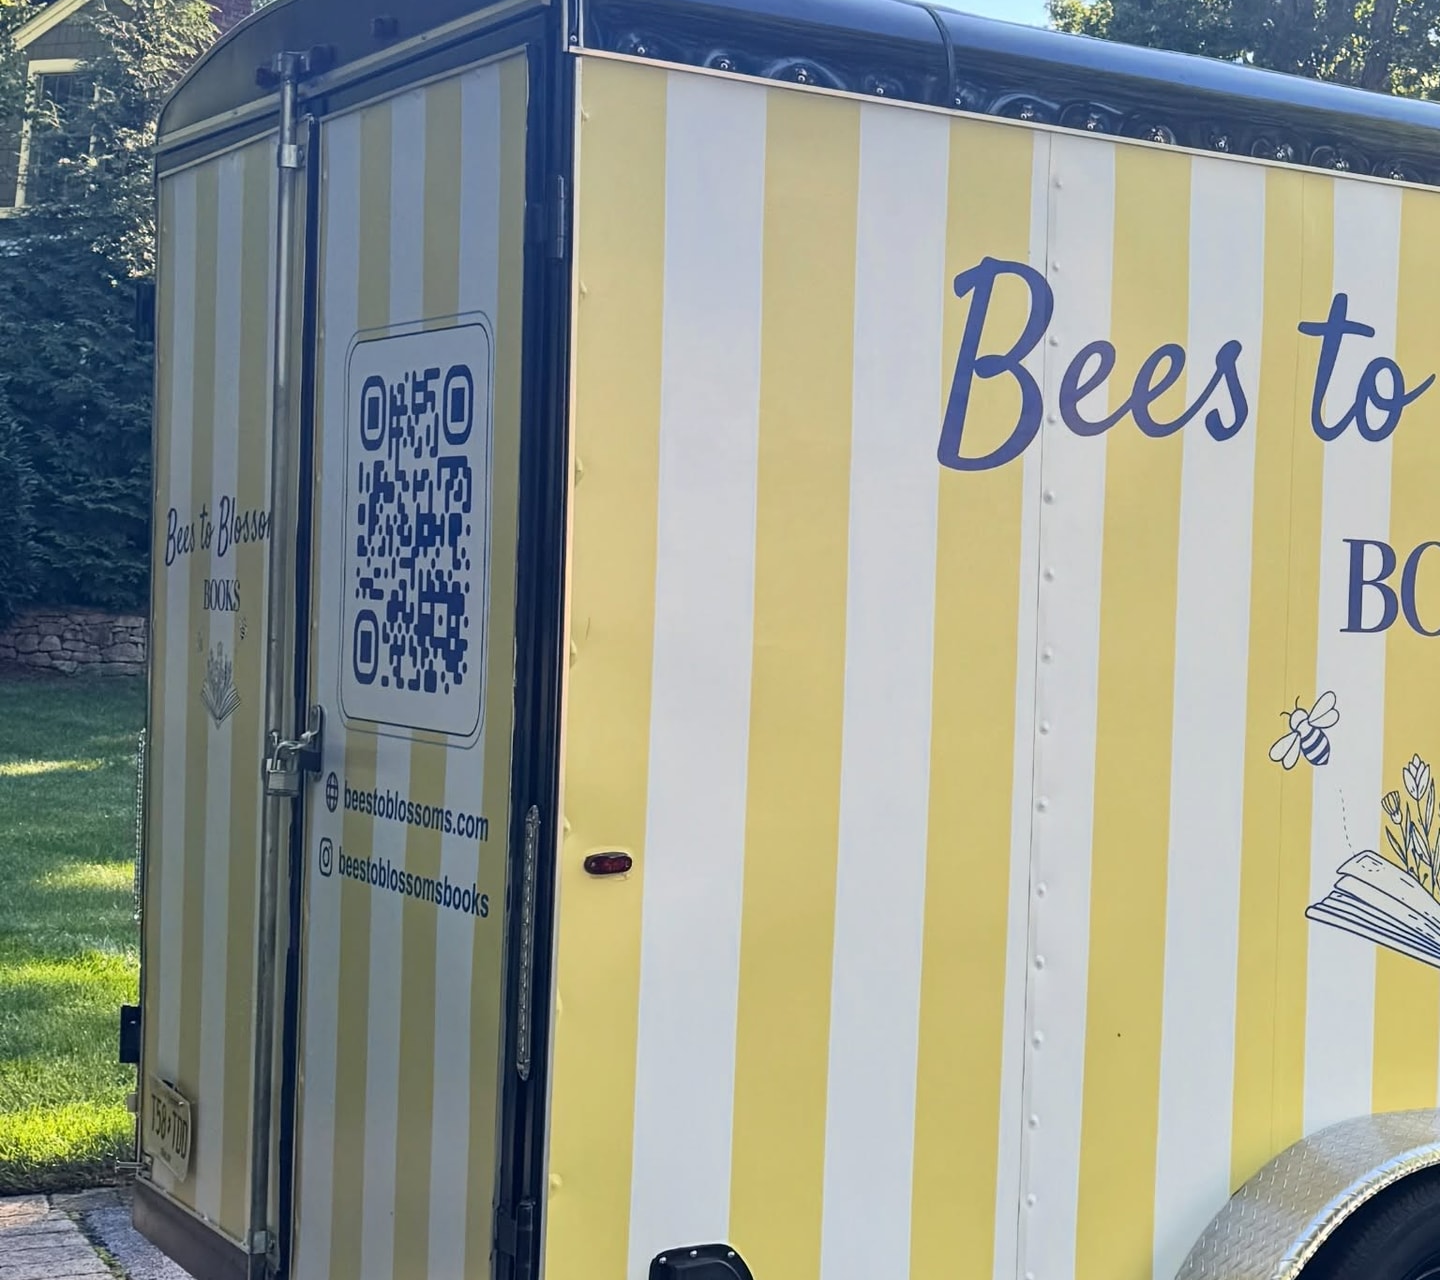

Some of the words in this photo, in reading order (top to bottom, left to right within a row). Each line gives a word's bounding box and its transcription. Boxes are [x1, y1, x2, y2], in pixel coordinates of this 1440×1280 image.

[936, 256, 1250, 472] Bees
[1297, 292, 1437, 443] to
[165, 507, 196, 567] Bees
[200, 503, 215, 550] to
[217, 495, 272, 558] Blosso
[203, 578, 241, 612] BOOKS
[344, 779, 489, 842] beestoblossoms.com
[338, 845, 490, 919] beestoblossomsbooks
